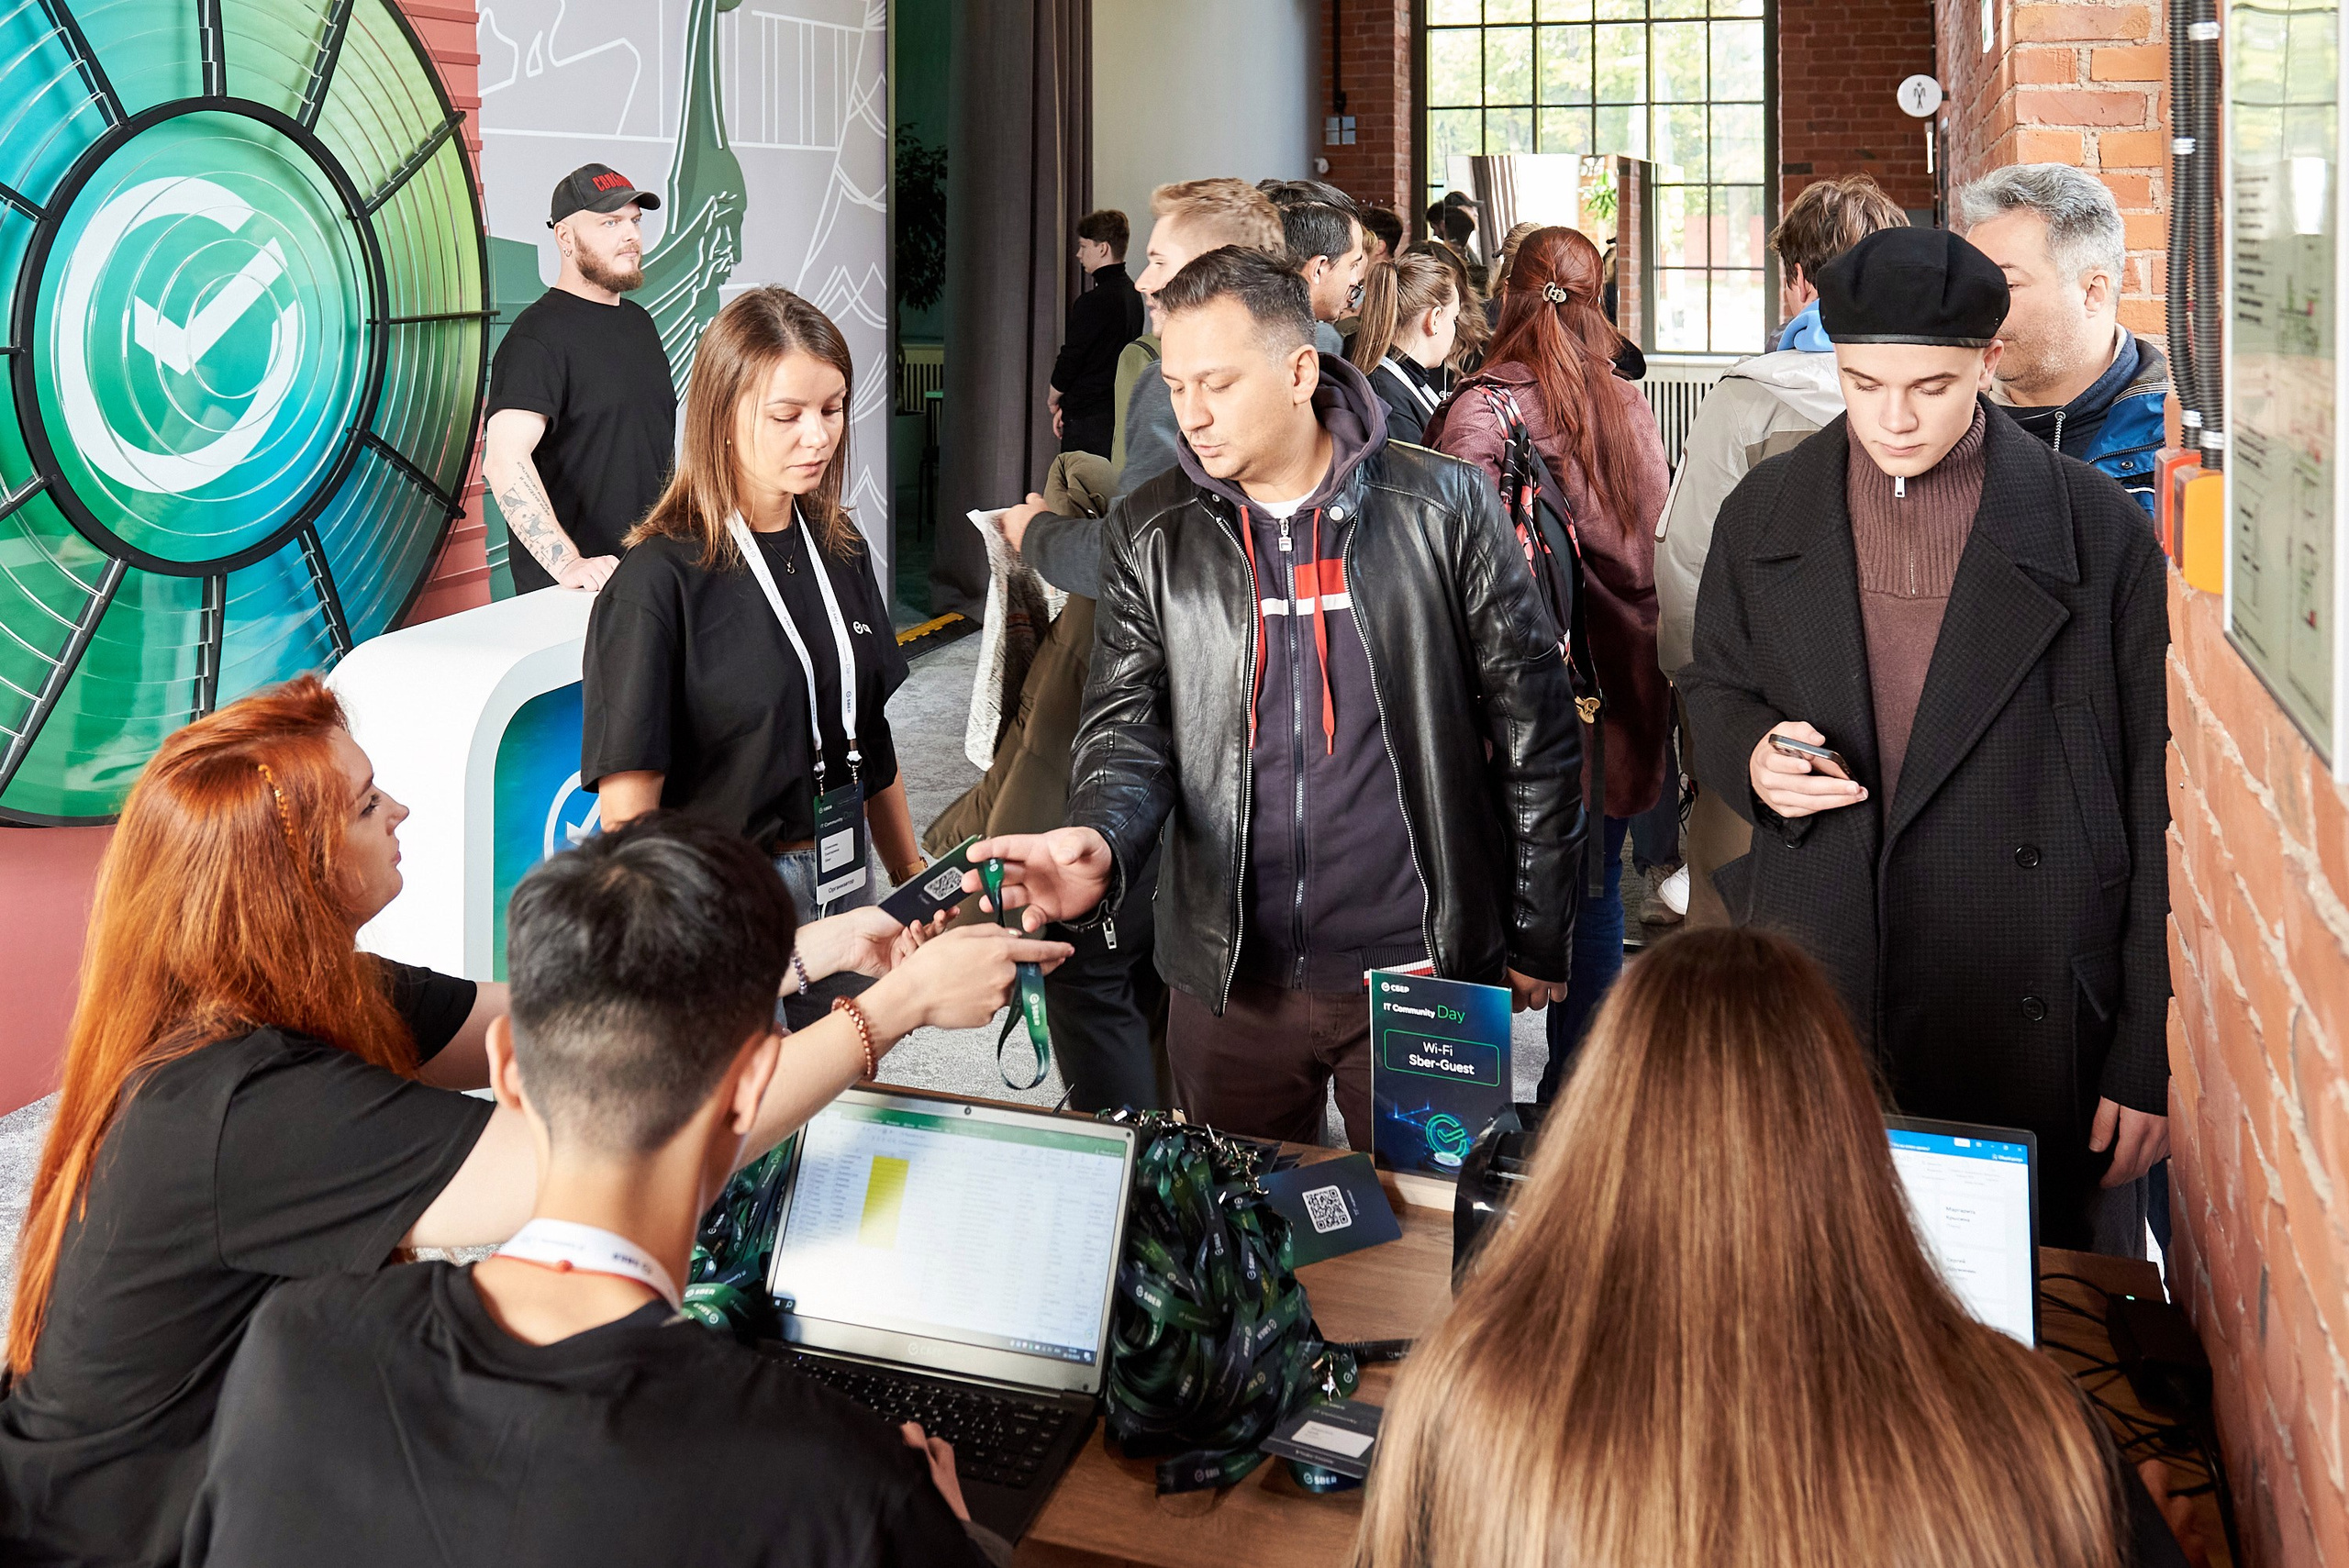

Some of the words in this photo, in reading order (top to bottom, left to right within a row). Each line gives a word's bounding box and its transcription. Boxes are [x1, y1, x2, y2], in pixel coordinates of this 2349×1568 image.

[1392, 1004, 1435, 1018] Community
[1437, 1005, 1465, 1024] Day
[1422, 1041, 1453, 1057] Wi-Fi
[1408, 1053, 1475, 1075] Sber-Guest
[1143, 1292, 1162, 1307] SBER
[1314, 1475, 1337, 1485] SBER
